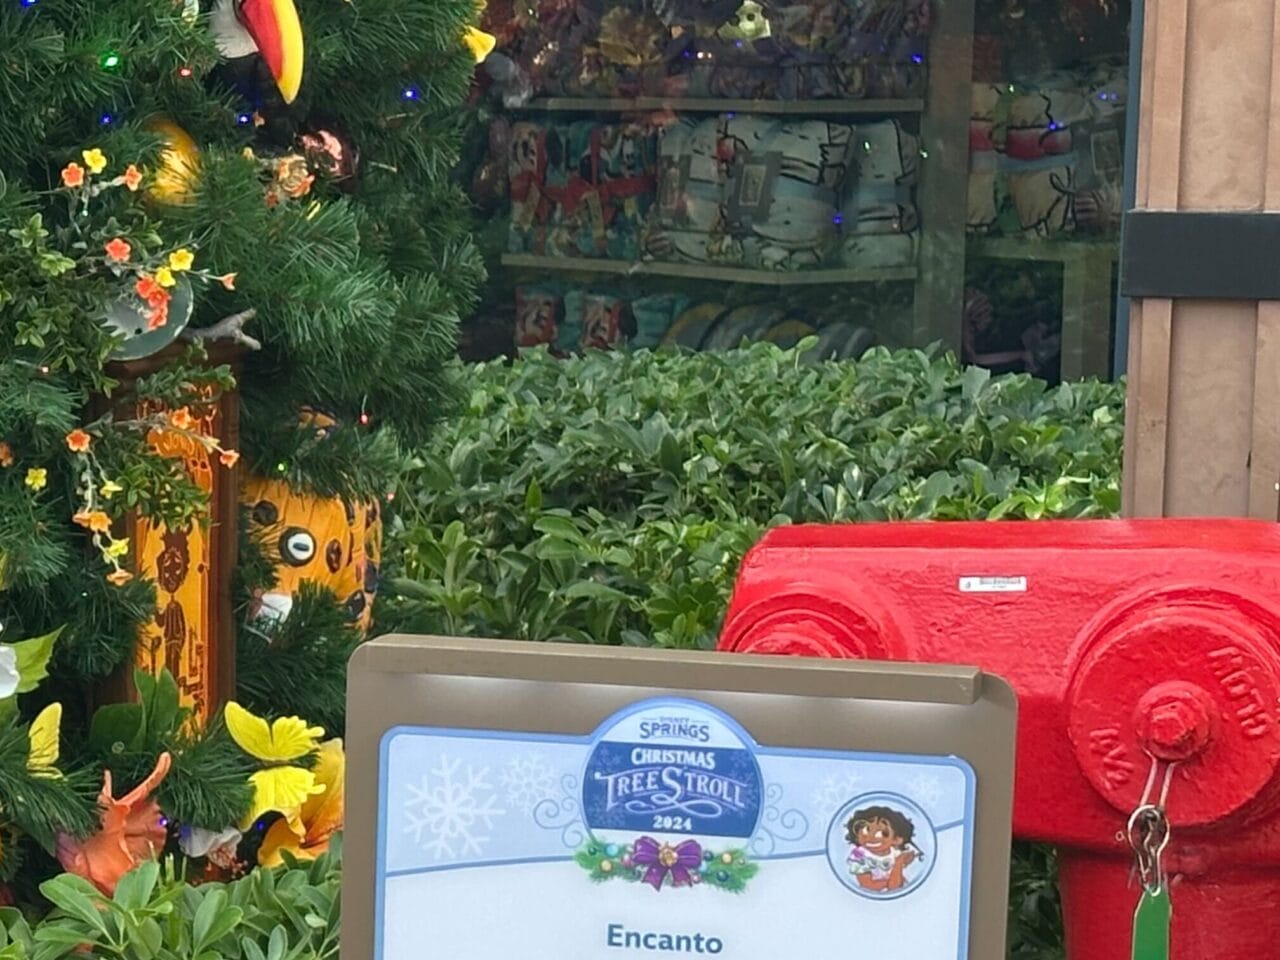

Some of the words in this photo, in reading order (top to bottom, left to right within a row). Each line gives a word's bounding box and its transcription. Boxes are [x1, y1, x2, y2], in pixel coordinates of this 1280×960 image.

[639, 721, 710, 743] SPRINGS
[630, 747, 716, 770] CHRISTMAS
[653, 815, 692, 831] 2024
[606, 923, 723, 954] Encanto
